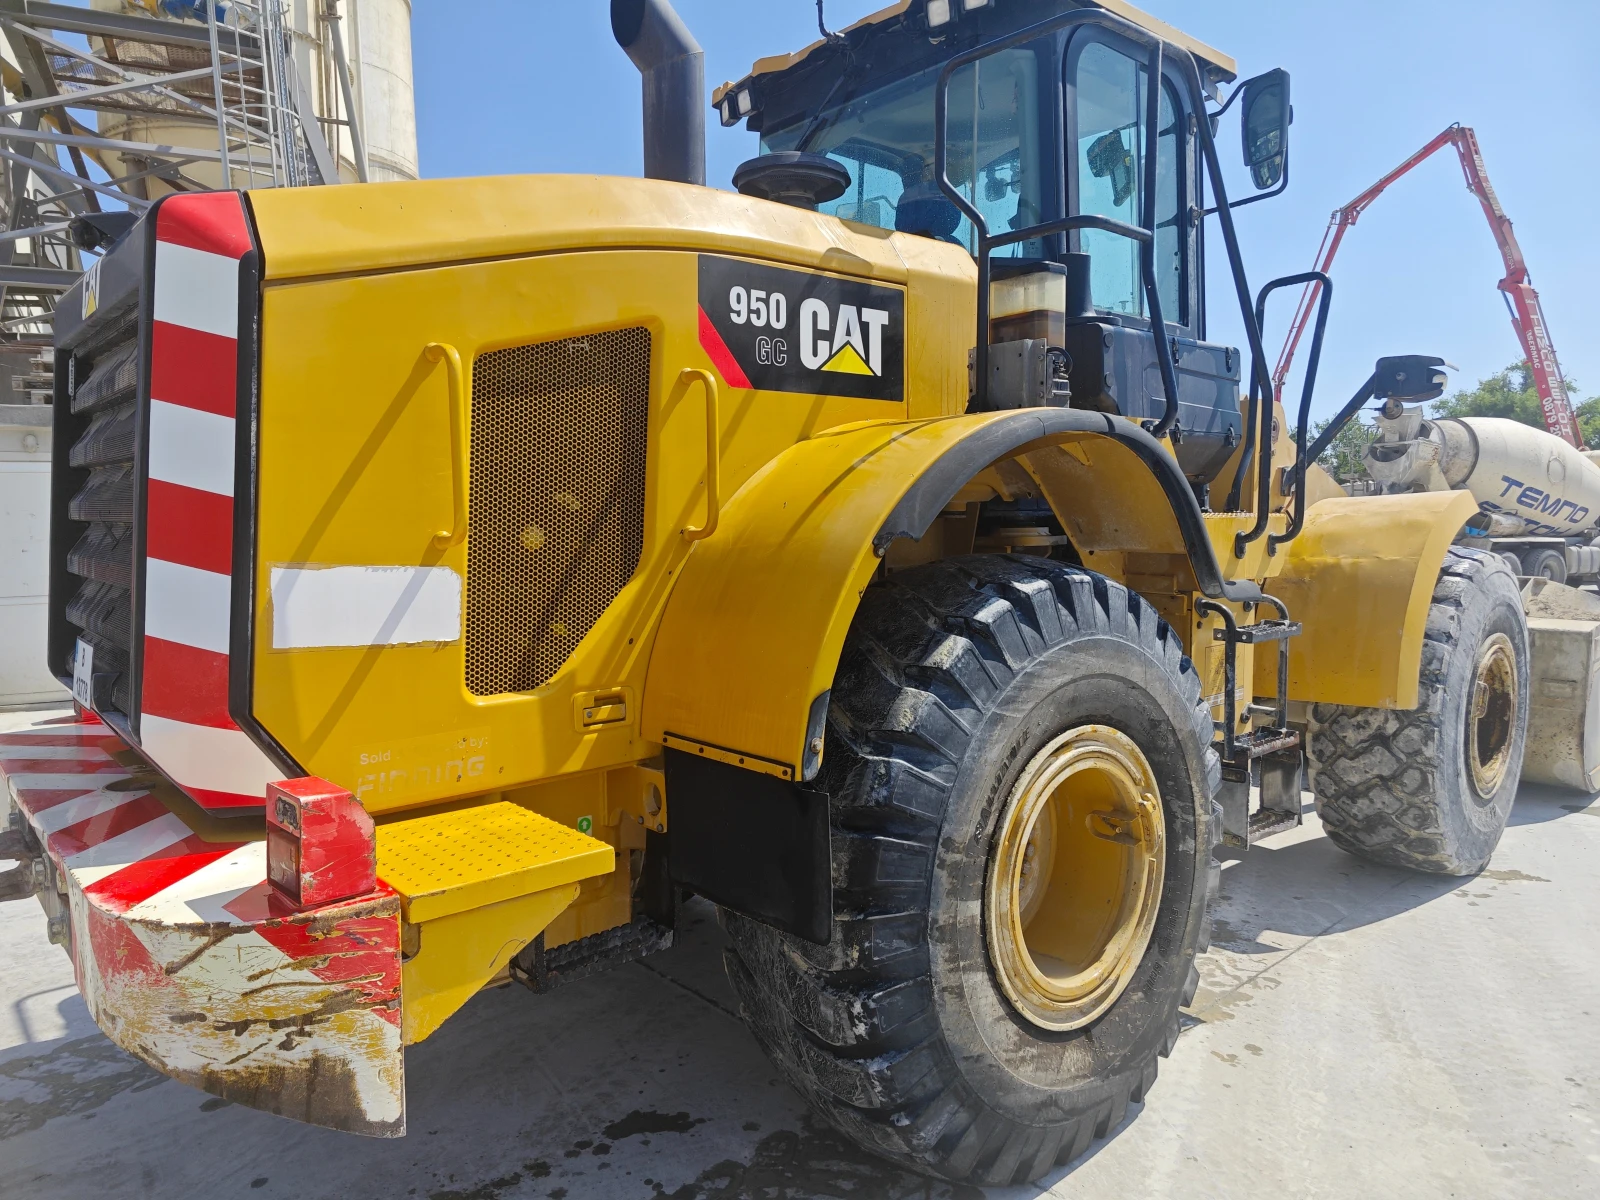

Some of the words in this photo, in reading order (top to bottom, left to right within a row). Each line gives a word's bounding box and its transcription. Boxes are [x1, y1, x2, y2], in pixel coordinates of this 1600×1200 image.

[729, 285, 787, 330] 950
[756, 335, 787, 367] GC
[800, 297, 889, 377] CAT
[1528, 332, 1541, 369] SERMAC
[1542, 397, 1557, 424] 0879
[360, 749, 391, 765] Sold
